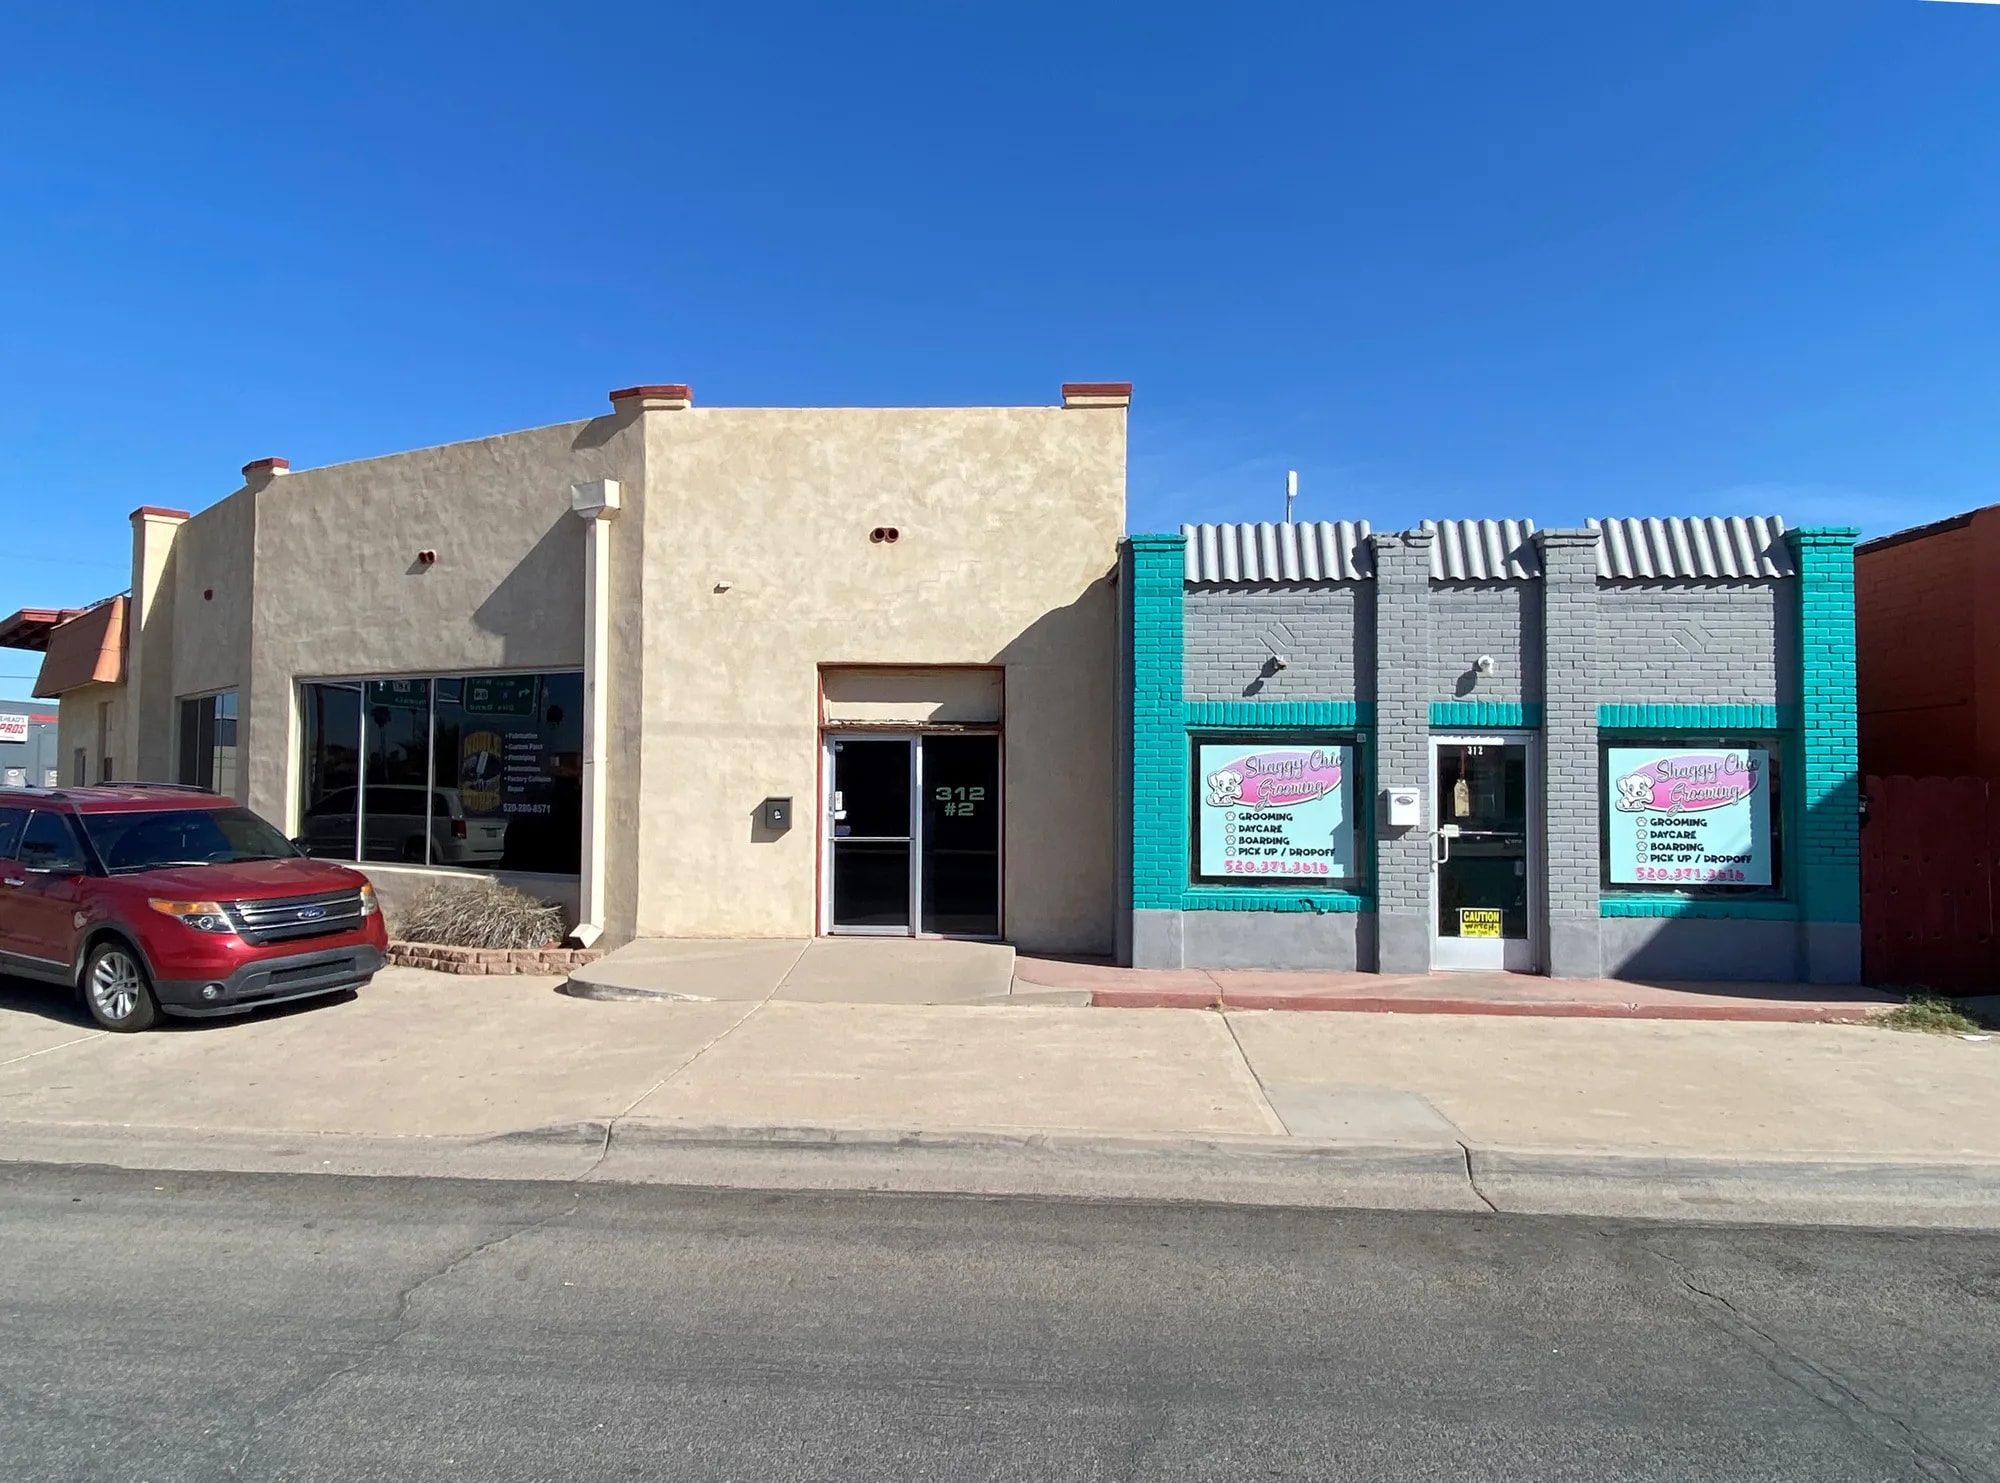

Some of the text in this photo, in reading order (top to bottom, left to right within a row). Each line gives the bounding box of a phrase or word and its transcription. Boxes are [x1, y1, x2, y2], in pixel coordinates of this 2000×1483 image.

[1467, 746, 1484, 755] 312
[1245, 750, 1345, 781] Shaggy Chic
[1656, 753, 1761, 785] Shaggy Chic
[935, 786, 985, 801] 312
[1255, 778, 1327, 811] Grooming
[1667, 783, 1744, 817] Grooming
[944, 802, 974, 816] #2
[1238, 811, 1293, 821] GROOMING
[1650, 817, 1708, 827] GROOMING
[1238, 824, 1283, 833] DAYCARE
[1650, 830, 1697, 839] DAYCARE
[1238, 836, 1290, 845] BOARDING
[1238, 847, 1261, 856] PICK
[1264, 847, 1278, 856] UP
[1289, 847, 1336, 857] DROPOFF
[1650, 842, 1704, 852] BOARDING
[1650, 853, 1674, 863] PICK
[1677, 854, 1692, 863] UP
[1704, 854, 1753, 864] DROPOFF
[1463, 910, 1500, 922] CAUTION
